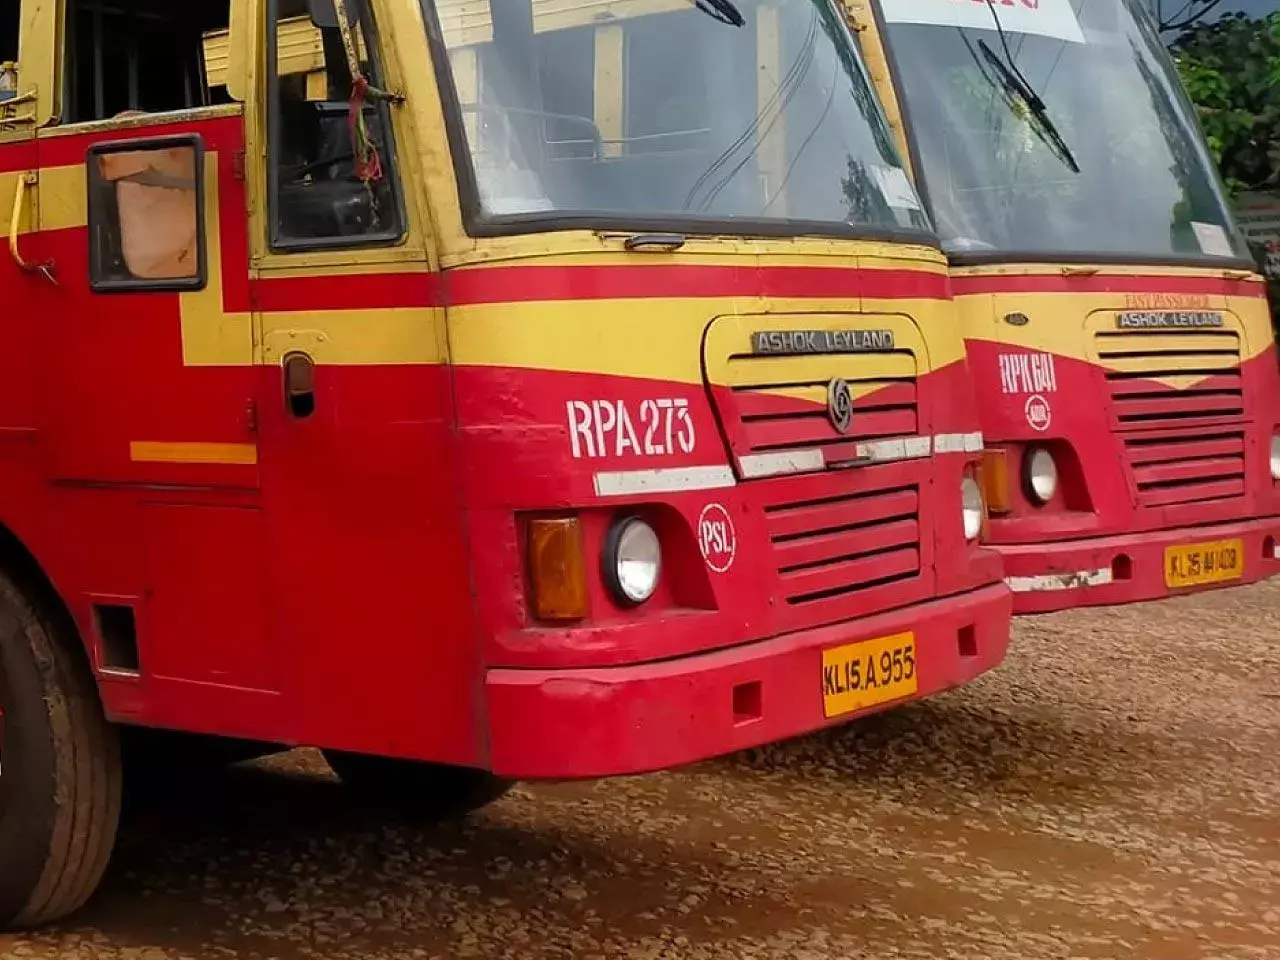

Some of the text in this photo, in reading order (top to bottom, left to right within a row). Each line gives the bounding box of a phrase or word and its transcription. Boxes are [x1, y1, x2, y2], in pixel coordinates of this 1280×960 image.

[1121, 312, 1168, 327] ASHOK
[758, 330, 894, 353] ASHOK LEYLAND
[702, 519, 733, 555] PSL
